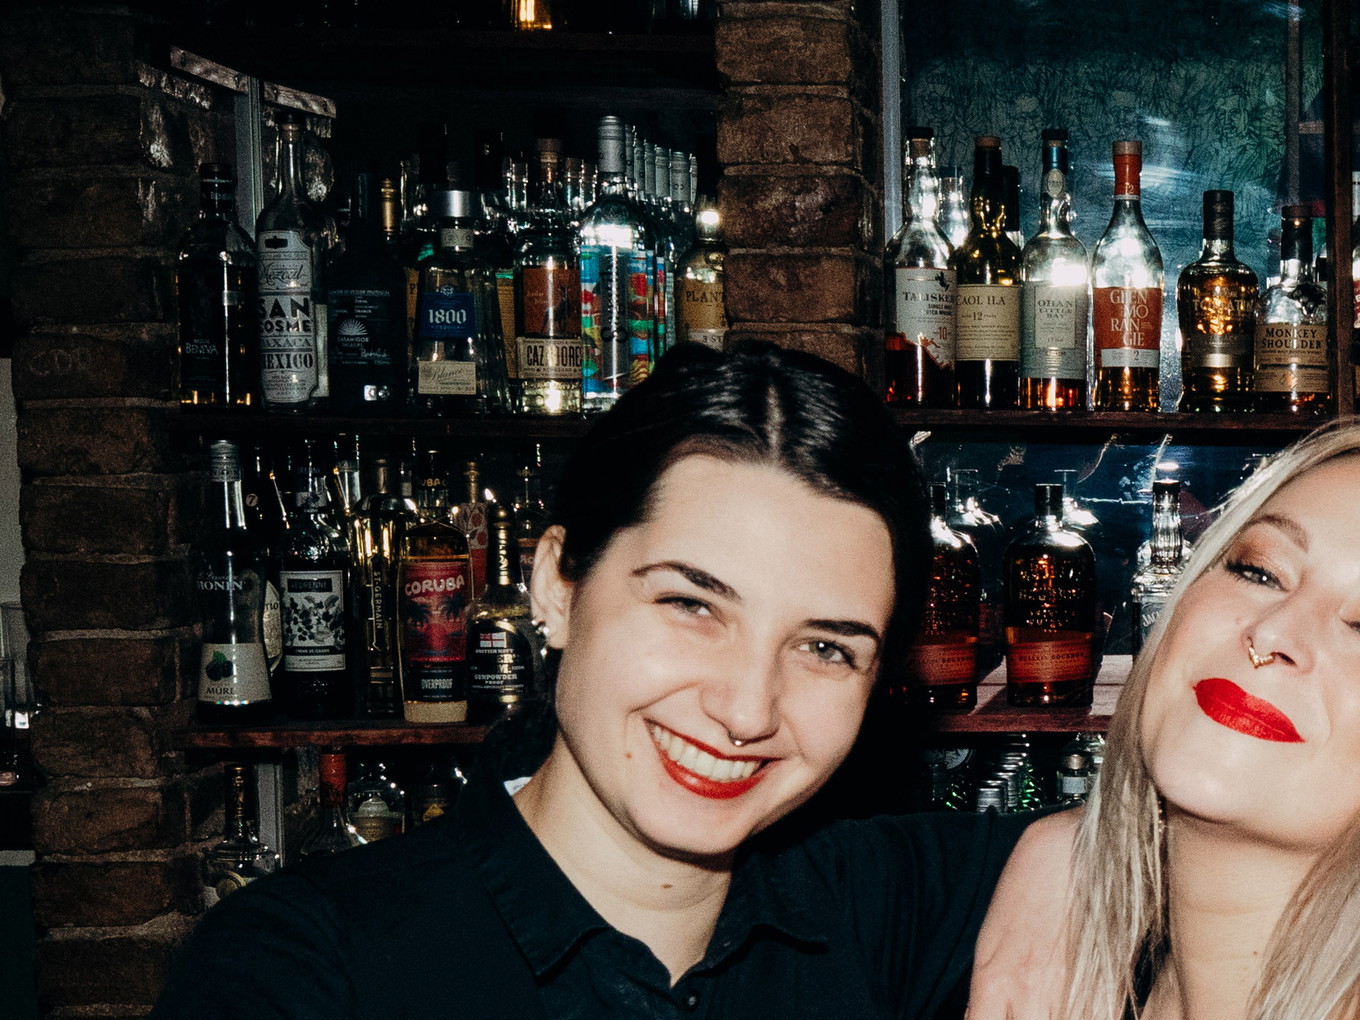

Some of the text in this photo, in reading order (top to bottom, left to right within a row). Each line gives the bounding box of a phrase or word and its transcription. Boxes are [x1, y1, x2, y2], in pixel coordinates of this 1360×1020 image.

[987, 295, 1007, 306] ILA
[428, 308, 467, 324] 1800
[972, 311, 983, 321] 12
[938, 326, 948, 340] 10
[1265, 327, 1318, 339] MONKEY
[185, 341, 219, 356] BENEVA
[1260, 338, 1322, 349] SHOUDER
[404, 574, 465, 597] CORUBA
[372, 570, 384, 630] ST-GERMAIN
